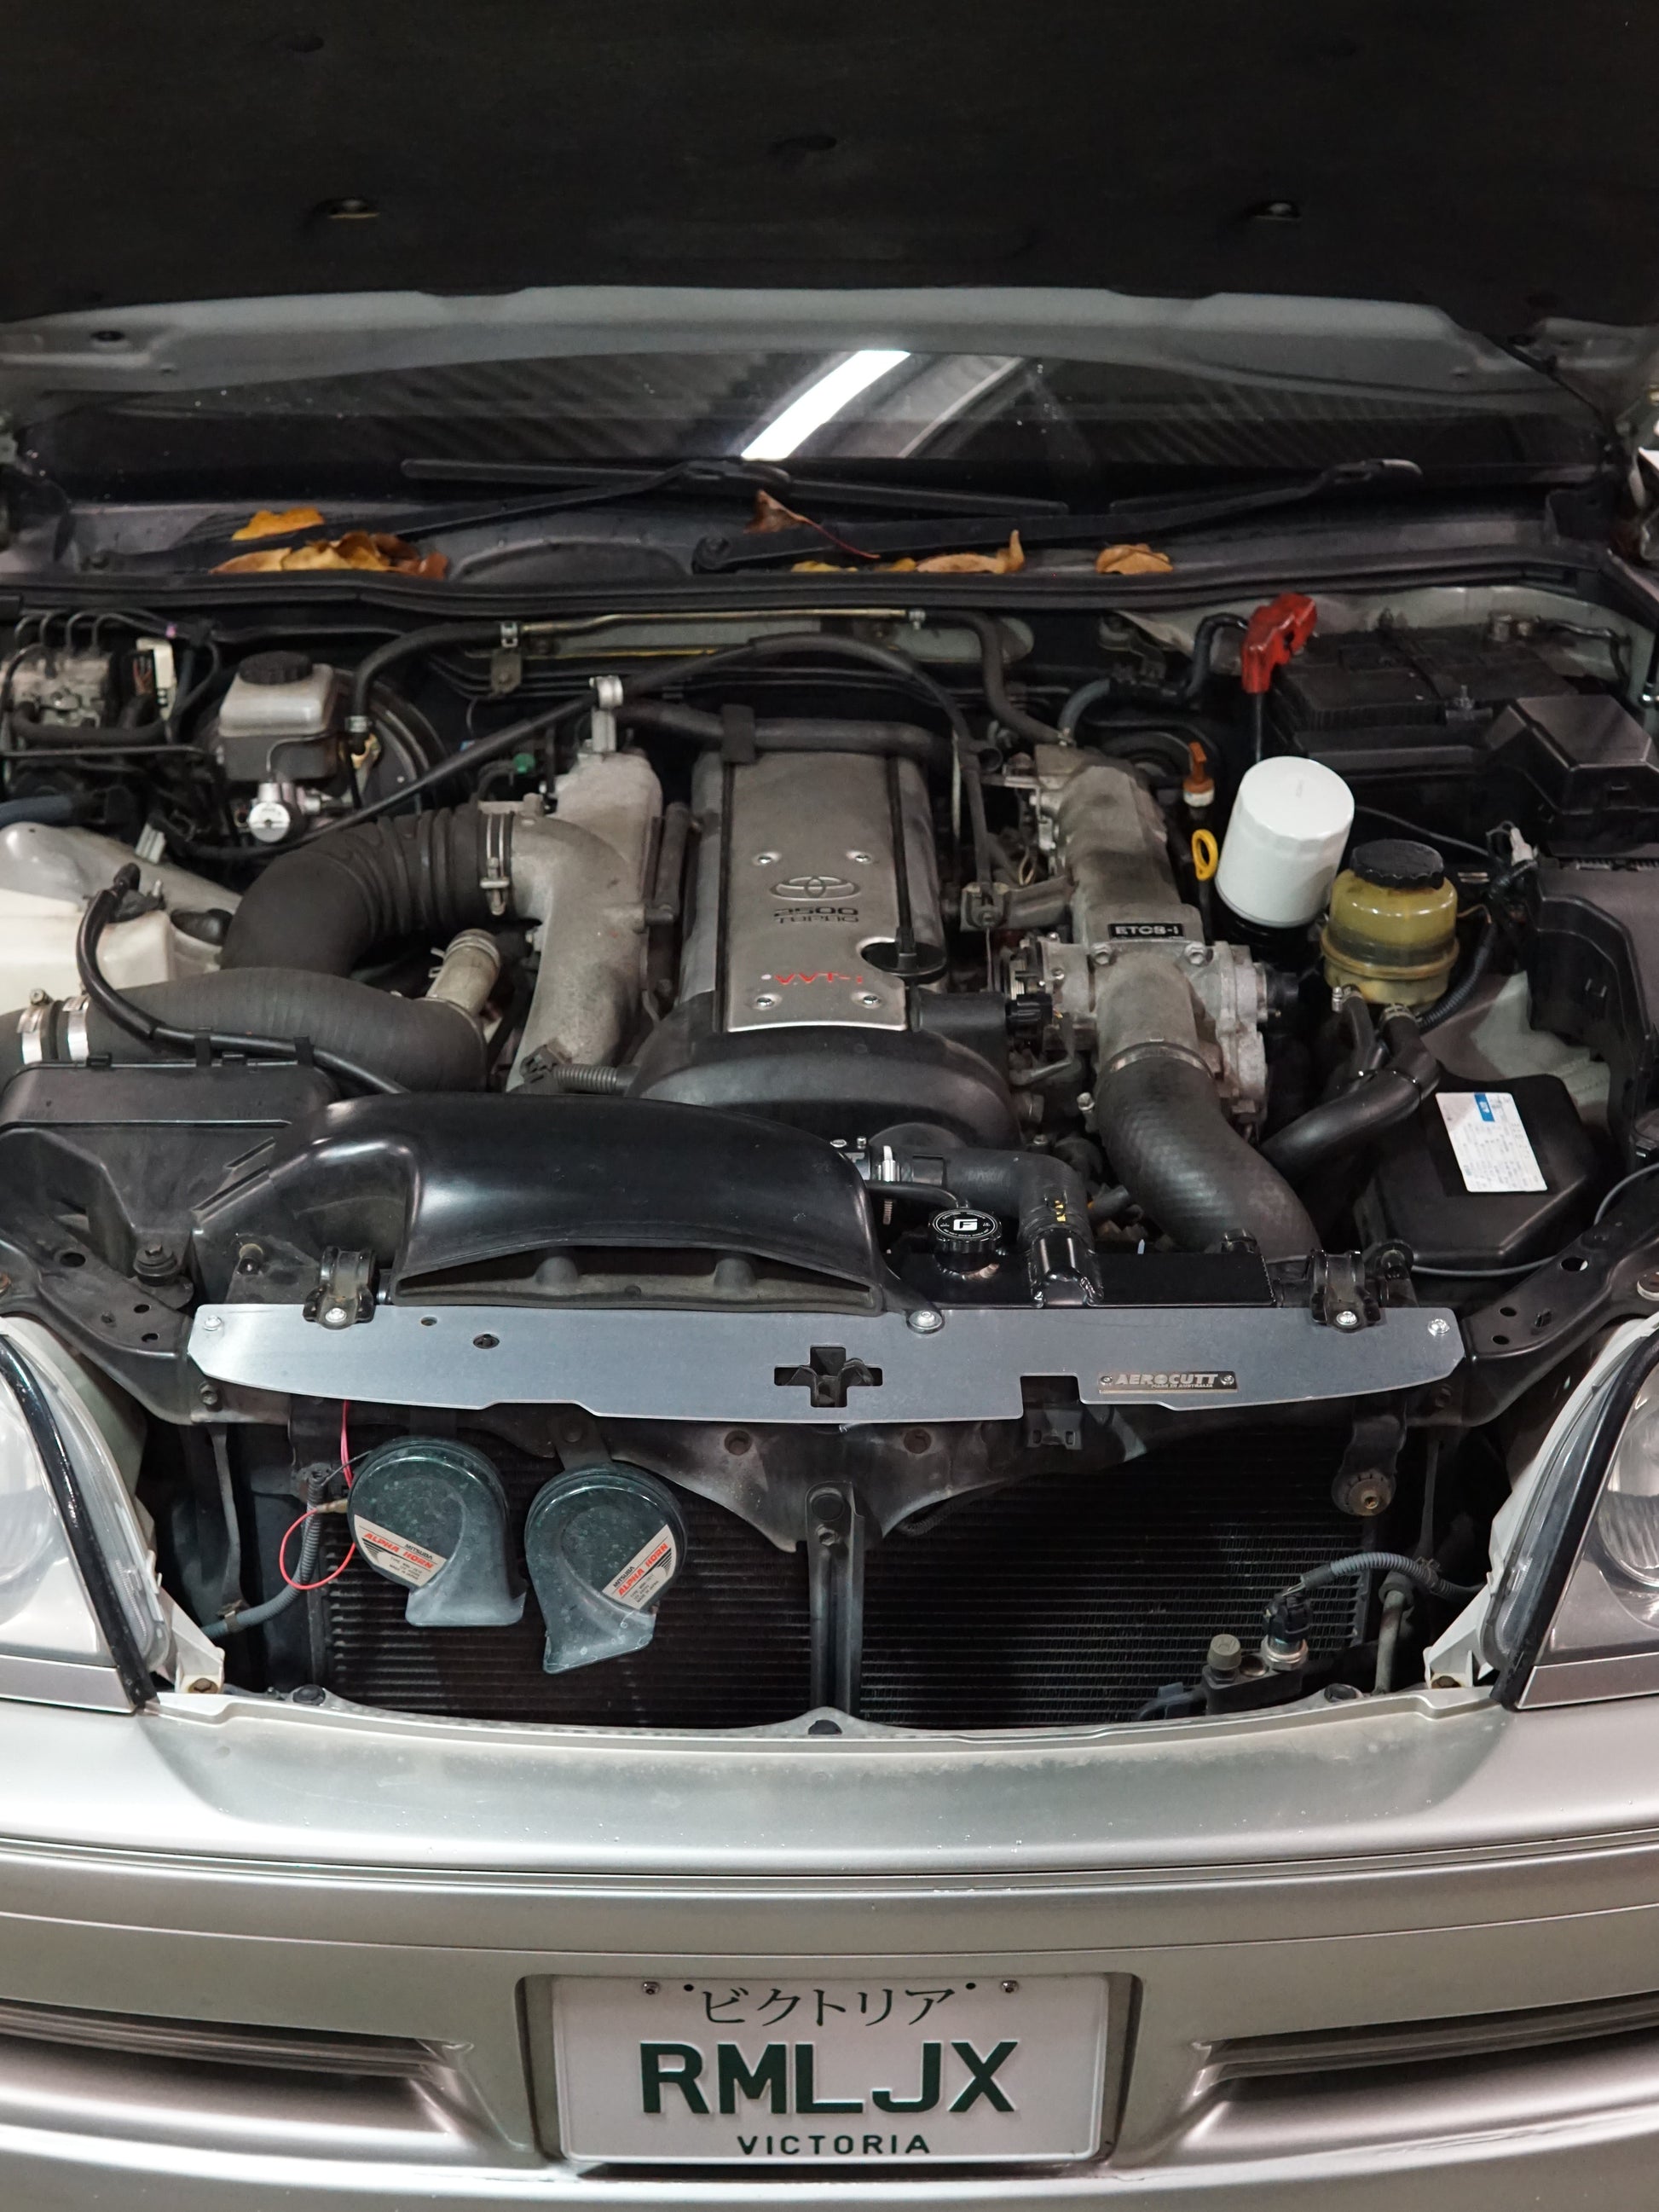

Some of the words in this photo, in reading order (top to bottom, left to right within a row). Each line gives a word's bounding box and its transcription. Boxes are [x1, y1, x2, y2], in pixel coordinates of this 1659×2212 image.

[1114, 1374, 1219, 1386] AEROCUTT
[363, 1532, 401, 1553] ALPHA
[402, 1550, 434, 1569] HORN
[405, 1543, 433, 1561] MITSUBA
[612, 1566, 635, 1588] MITSUBA
[618, 1567, 645, 1596] ALPHA
[645, 1543, 669, 1567] HORN
[702, 1987, 955, 2027] ビクトリア
[639, 2041, 1019, 2115] RMLJX
[737, 2134, 931, 2155] VICTORIA
